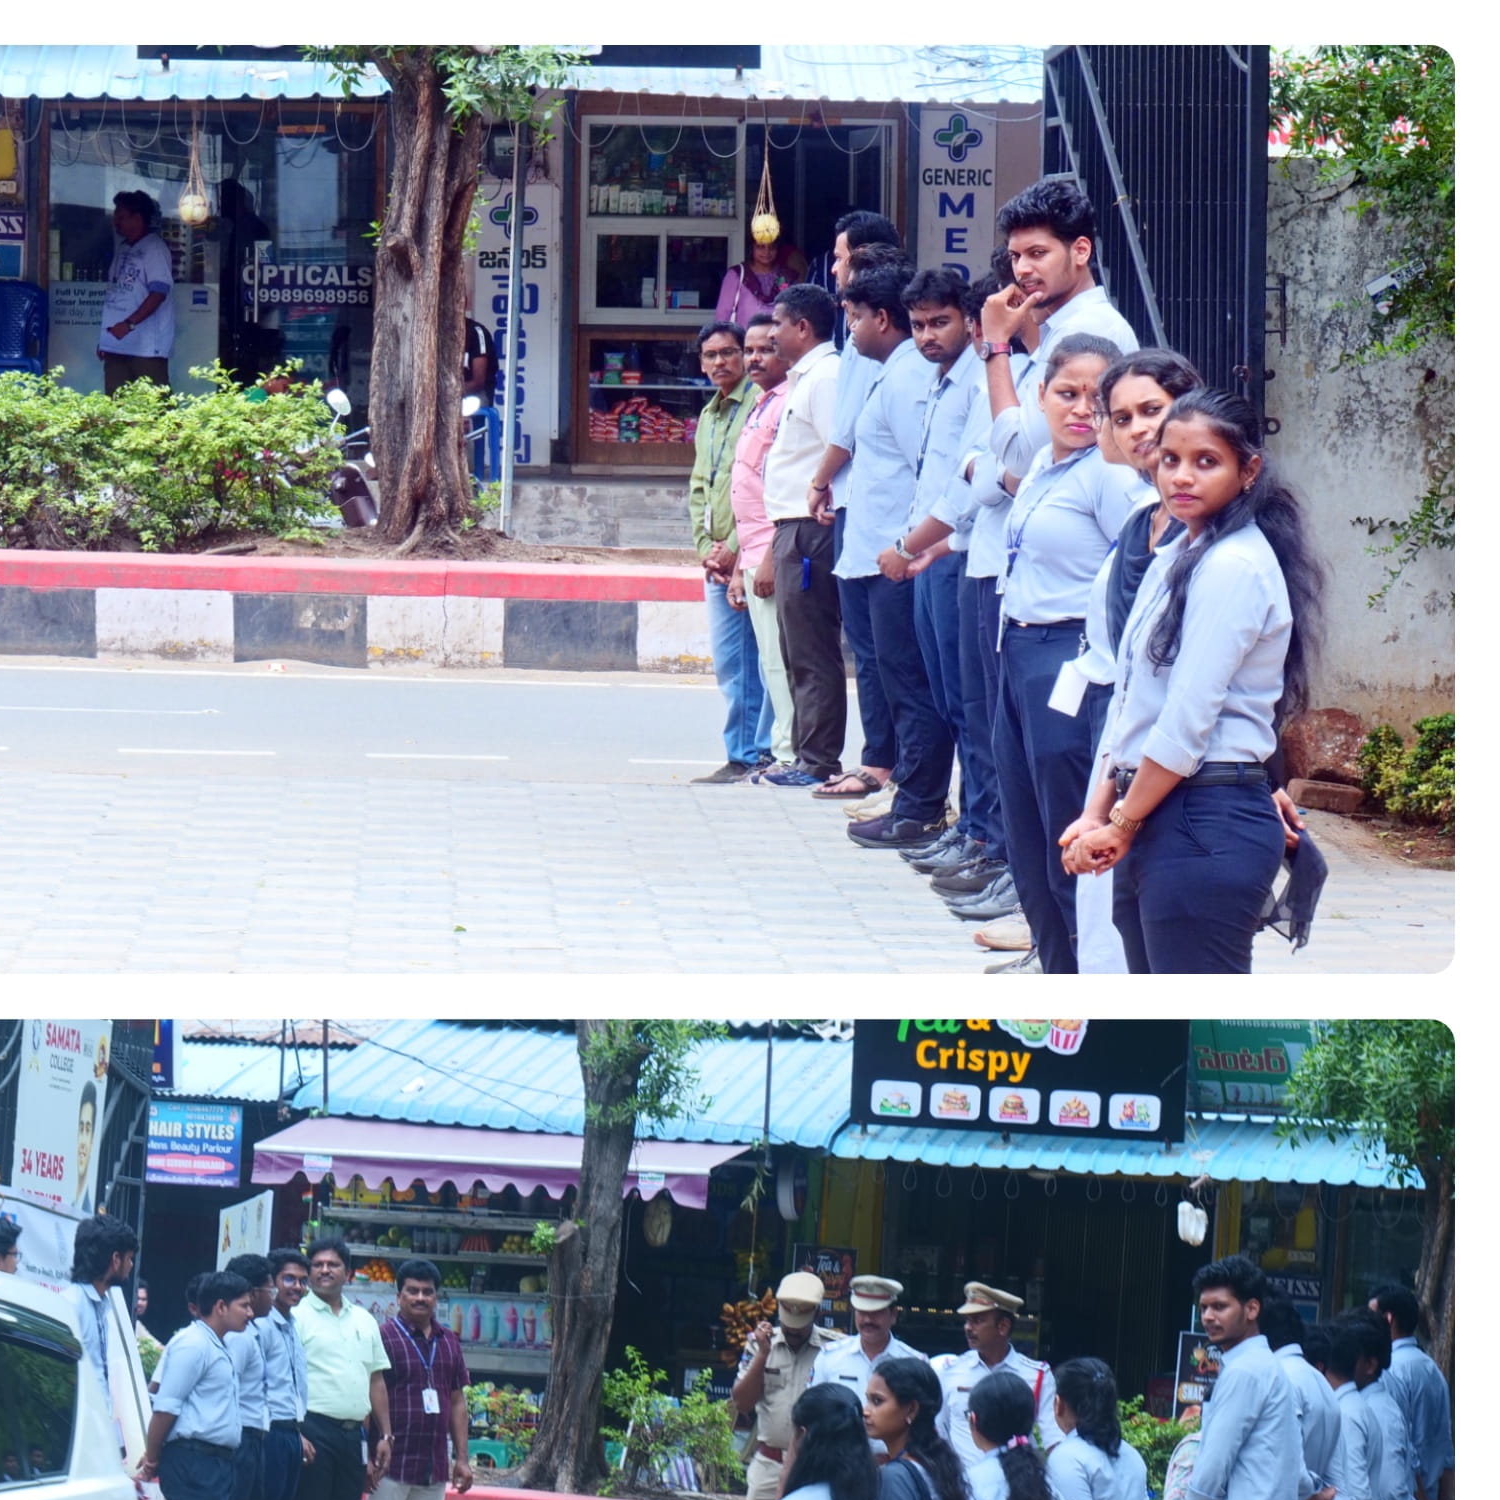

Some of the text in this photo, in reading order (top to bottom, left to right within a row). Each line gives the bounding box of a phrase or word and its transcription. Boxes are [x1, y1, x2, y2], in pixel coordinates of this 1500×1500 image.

[922, 168, 993, 186] GENERIC
[242, 264, 373, 287] OPTICALS
[258, 288, 369, 304] 9989698956
[45, 1022, 81, 1054] SAMATA
[915, 1039, 1032, 1083] Crispy
[148, 1120, 235, 1142] HAIR STYLES
[170, 1140, 200, 1156] Beauty
[202, 1142, 233, 1154] Parlour
[21, 1149, 65, 1181] 34 YEARS
